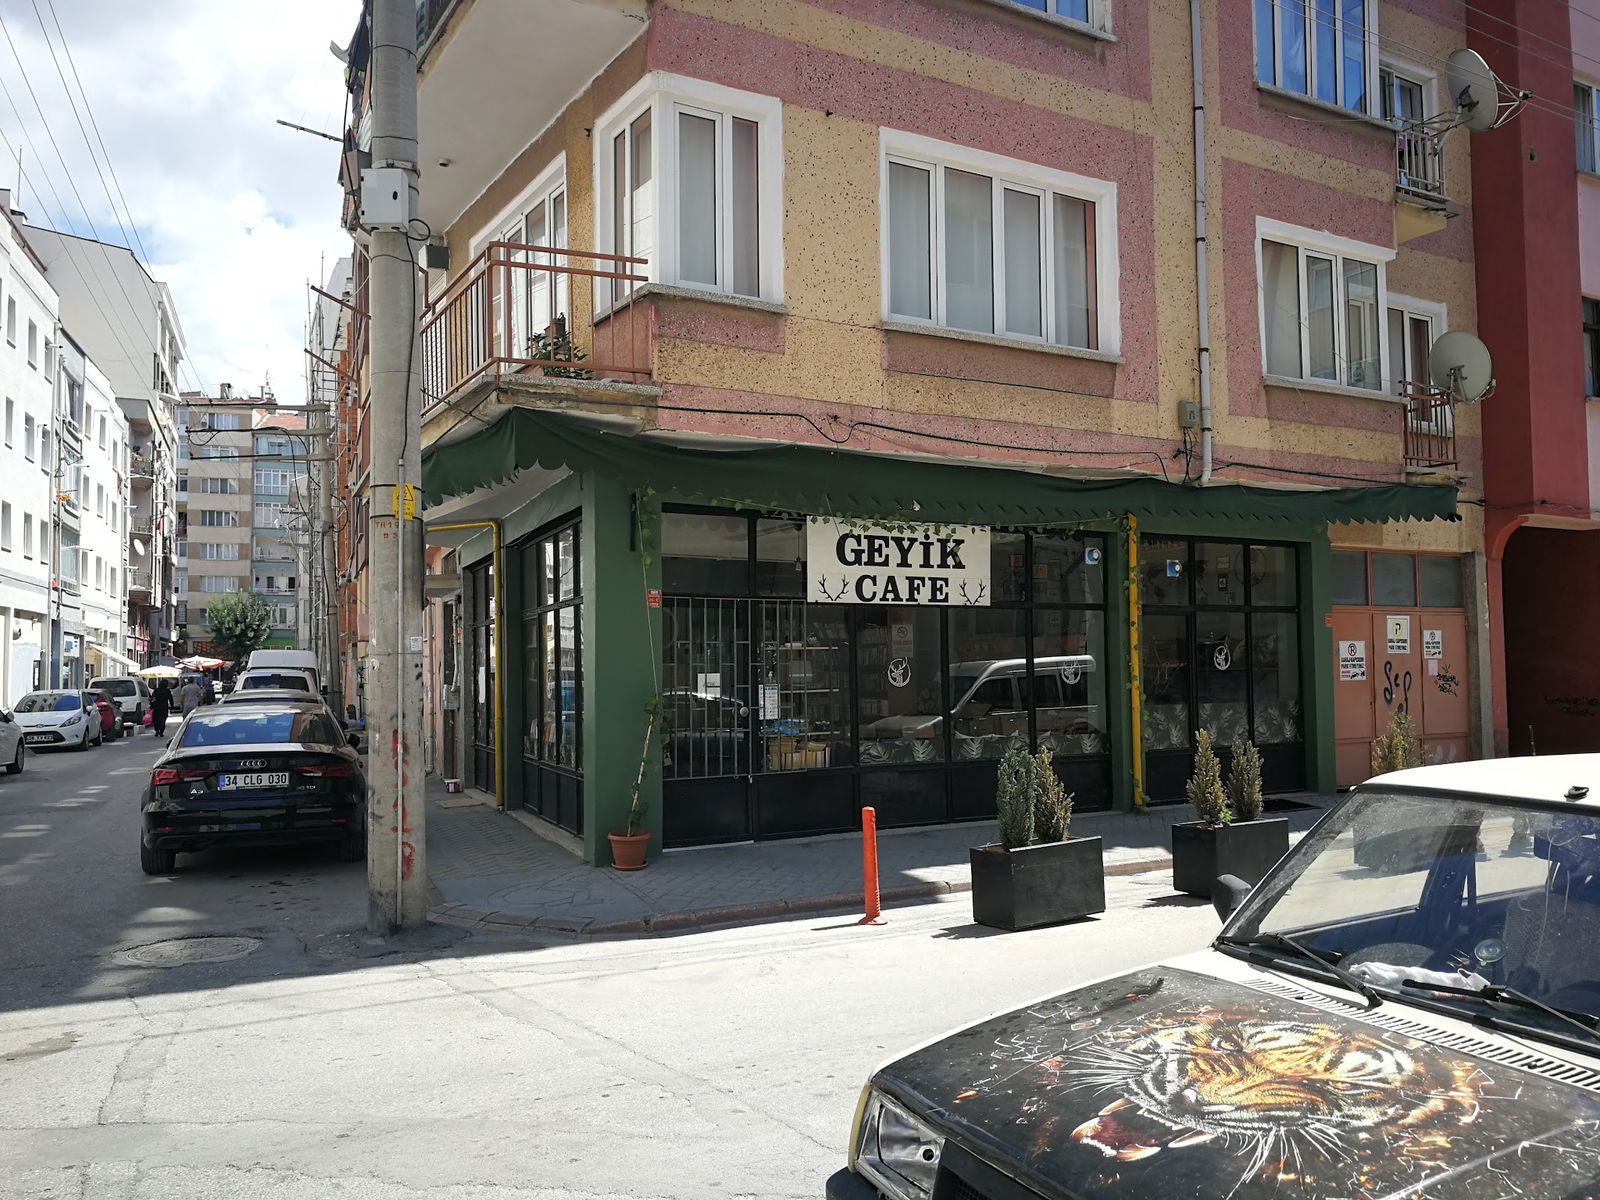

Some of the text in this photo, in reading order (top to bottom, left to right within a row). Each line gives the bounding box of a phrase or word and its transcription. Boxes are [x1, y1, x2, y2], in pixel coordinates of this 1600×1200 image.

[836, 532, 966, 570] GEYİK
[854, 574, 950, 603] CAFE
[225, 773, 287, 786] 34 CLG 030
